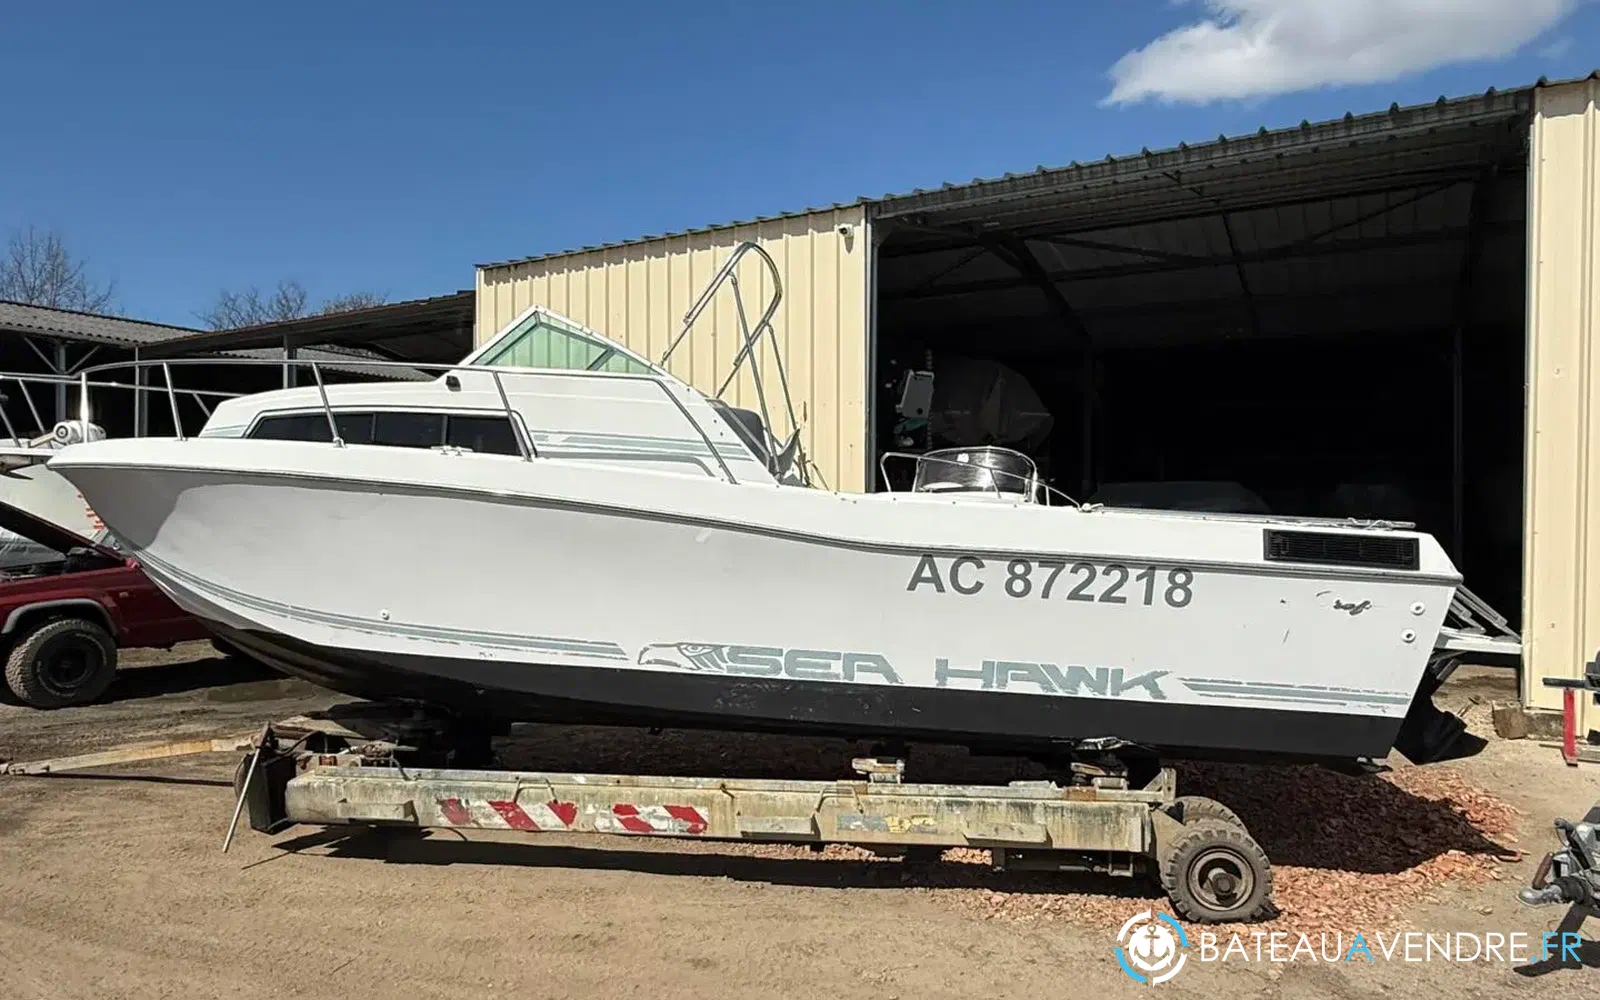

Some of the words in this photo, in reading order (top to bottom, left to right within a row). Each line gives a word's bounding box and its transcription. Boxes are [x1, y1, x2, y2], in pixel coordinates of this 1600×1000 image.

[907, 554, 985, 595] AC
[1004, 560, 1194, 608] 872218
[724, 646, 904, 684] SEA
[935, 657, 1173, 700] HAWK
